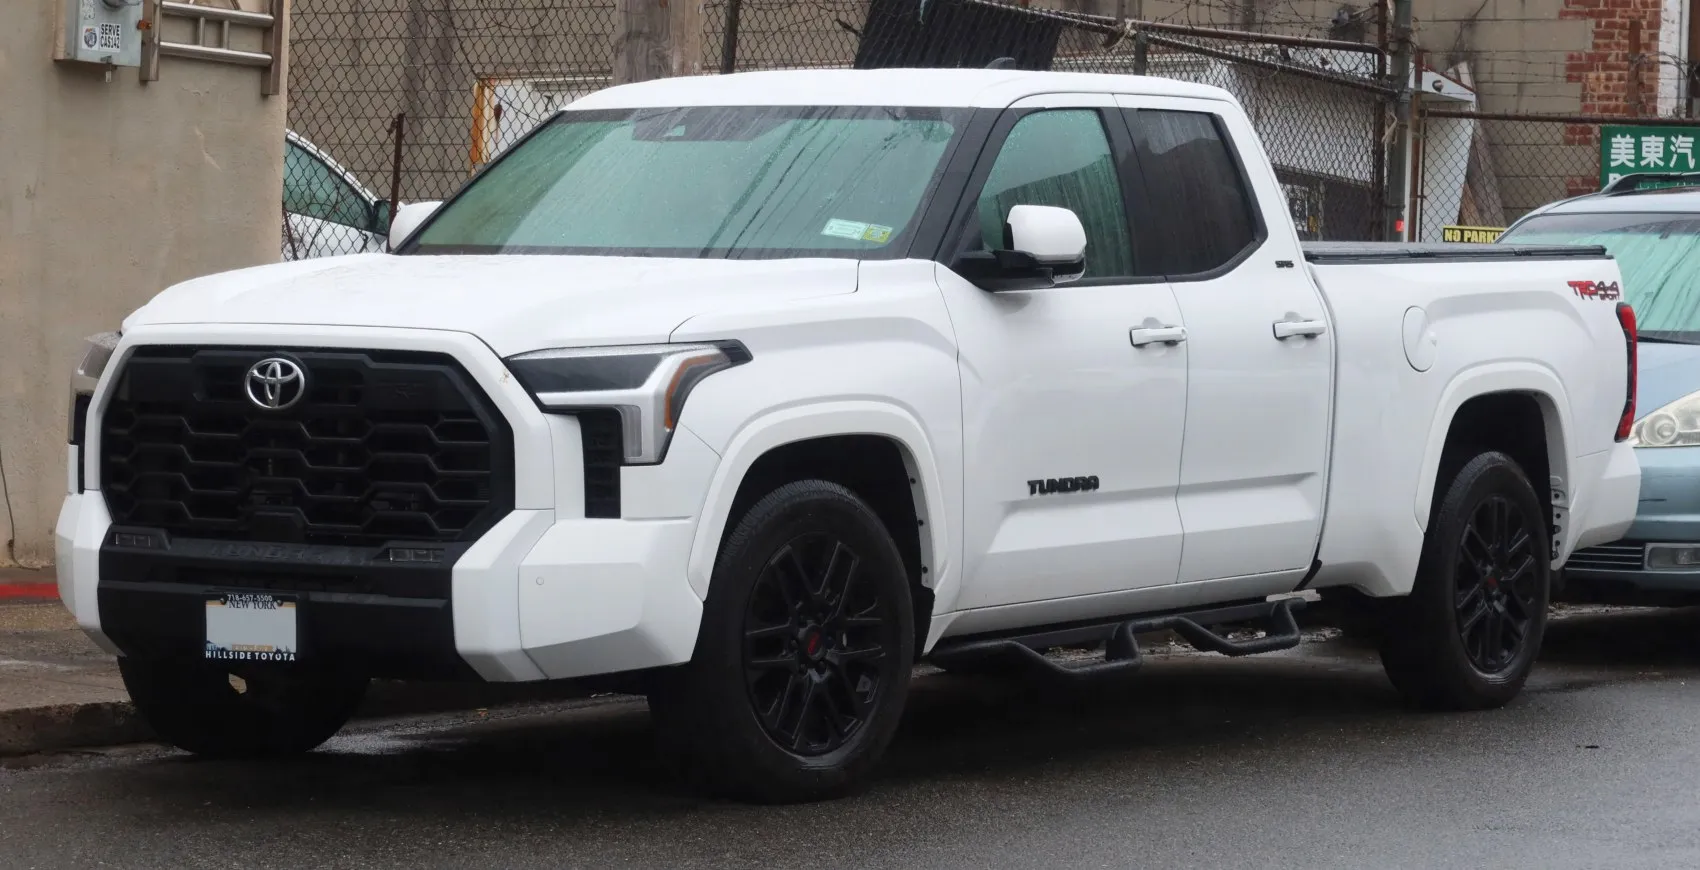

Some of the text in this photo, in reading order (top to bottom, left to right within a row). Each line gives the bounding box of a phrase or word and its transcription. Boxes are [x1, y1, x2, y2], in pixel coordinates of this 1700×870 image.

[101, 24, 120, 36] SERVE
[1610, 133, 1696, 169] 美東汽
[1444, 229, 1461, 241] NO
[1027, 476, 1099, 496] TUNDRA
[228, 600, 276, 610] NEW YORK
[205, 651, 295, 661] HILLSIDE TOYOTA
